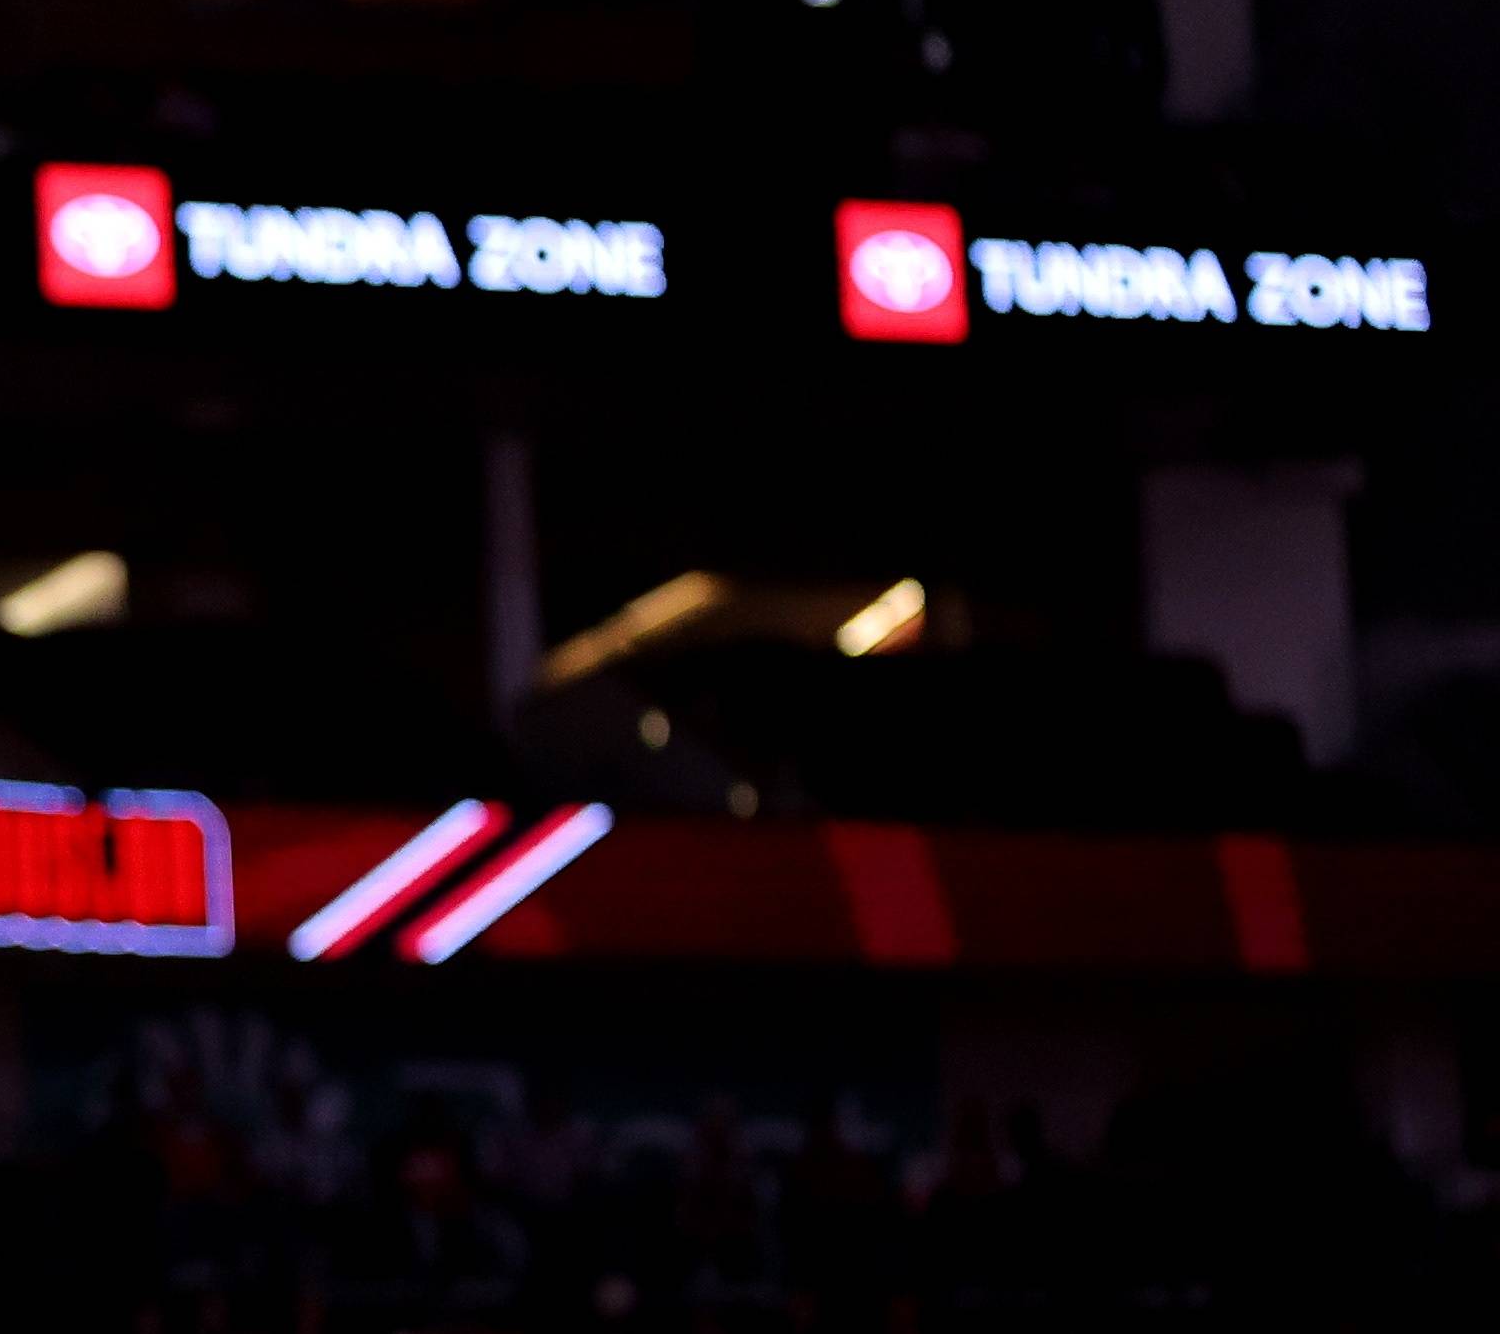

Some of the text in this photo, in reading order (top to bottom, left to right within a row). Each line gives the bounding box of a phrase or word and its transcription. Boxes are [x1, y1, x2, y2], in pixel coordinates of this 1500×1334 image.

[176, 201, 667, 298] TUNDRA ZONE
[968, 237, 1431, 332] TUNDRA ZONE
